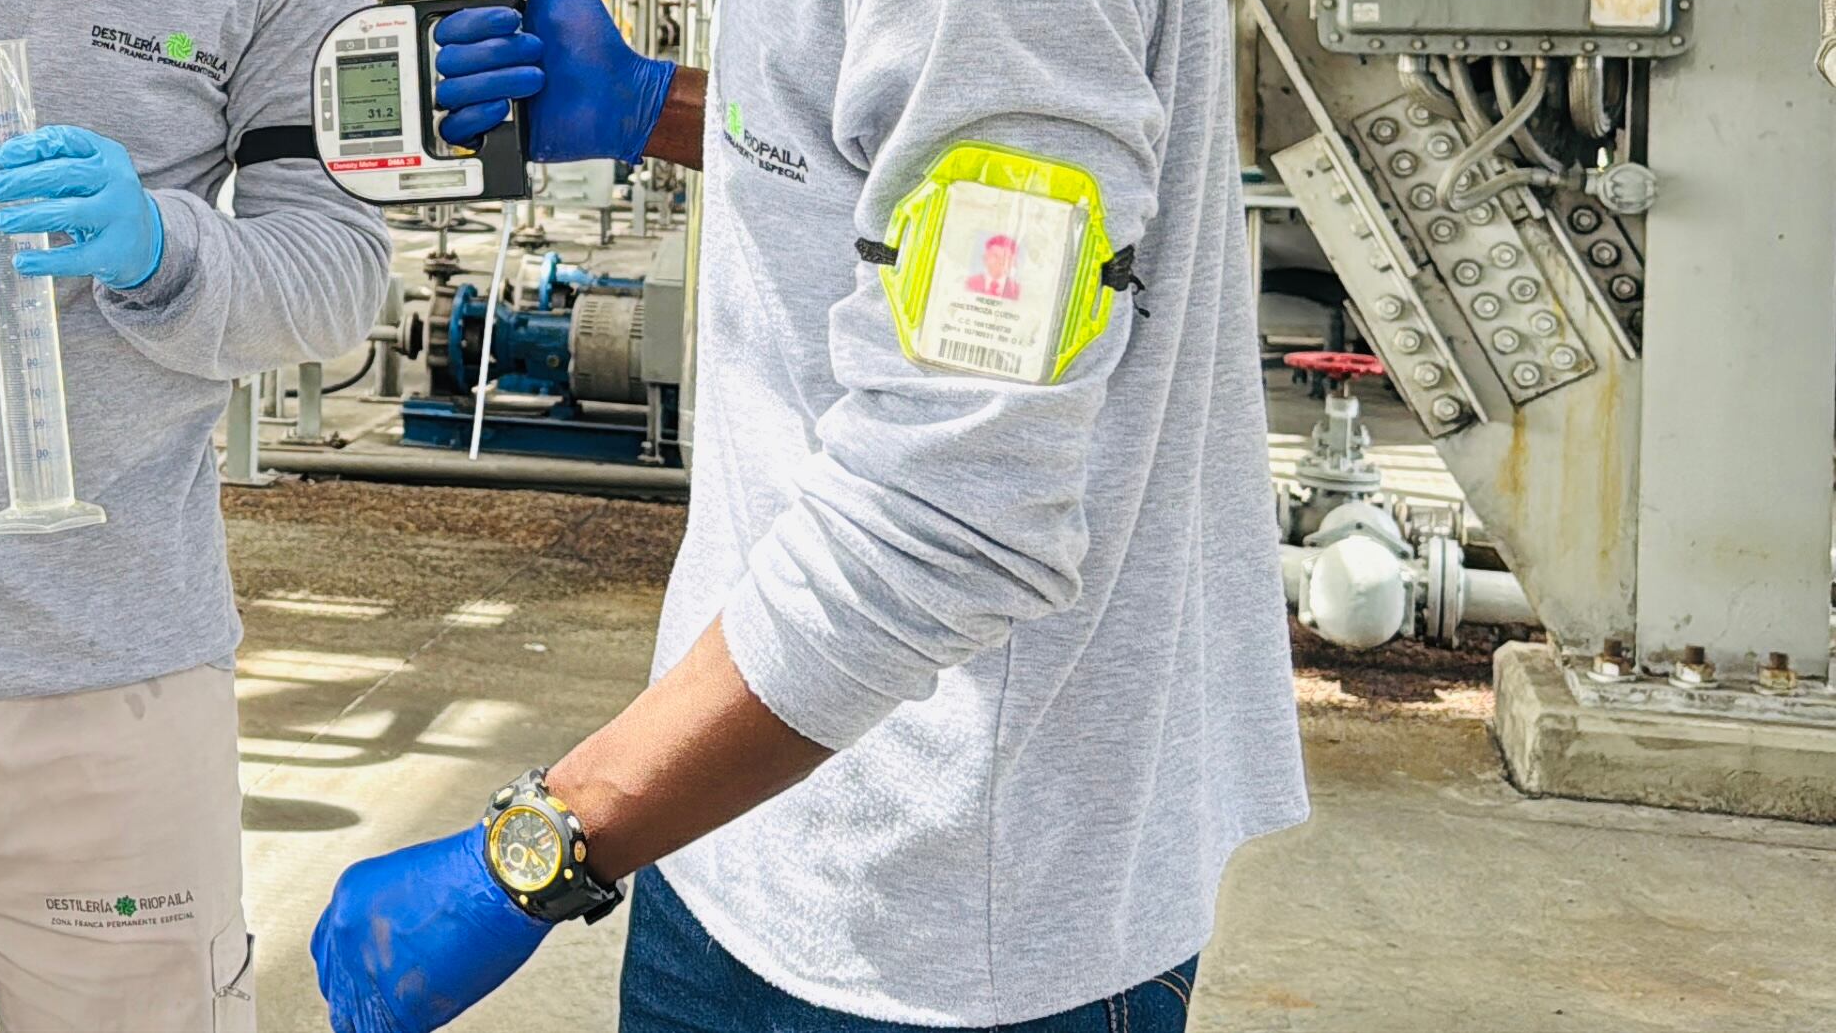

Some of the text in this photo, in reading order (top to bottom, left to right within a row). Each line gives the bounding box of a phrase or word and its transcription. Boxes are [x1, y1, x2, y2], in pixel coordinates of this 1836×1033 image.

[91, 24, 162, 55] DESTILERÍA
[367, 107, 394, 119] 31.2
[743, 128, 809, 173] RIOPAILA
[45, 889, 195, 914] DESTILERÍA RIOPAILA
[51, 918, 72, 927] ZONA
[74, 919, 104, 929] FRANCA
[106, 918, 157, 929] PERMANENTE
